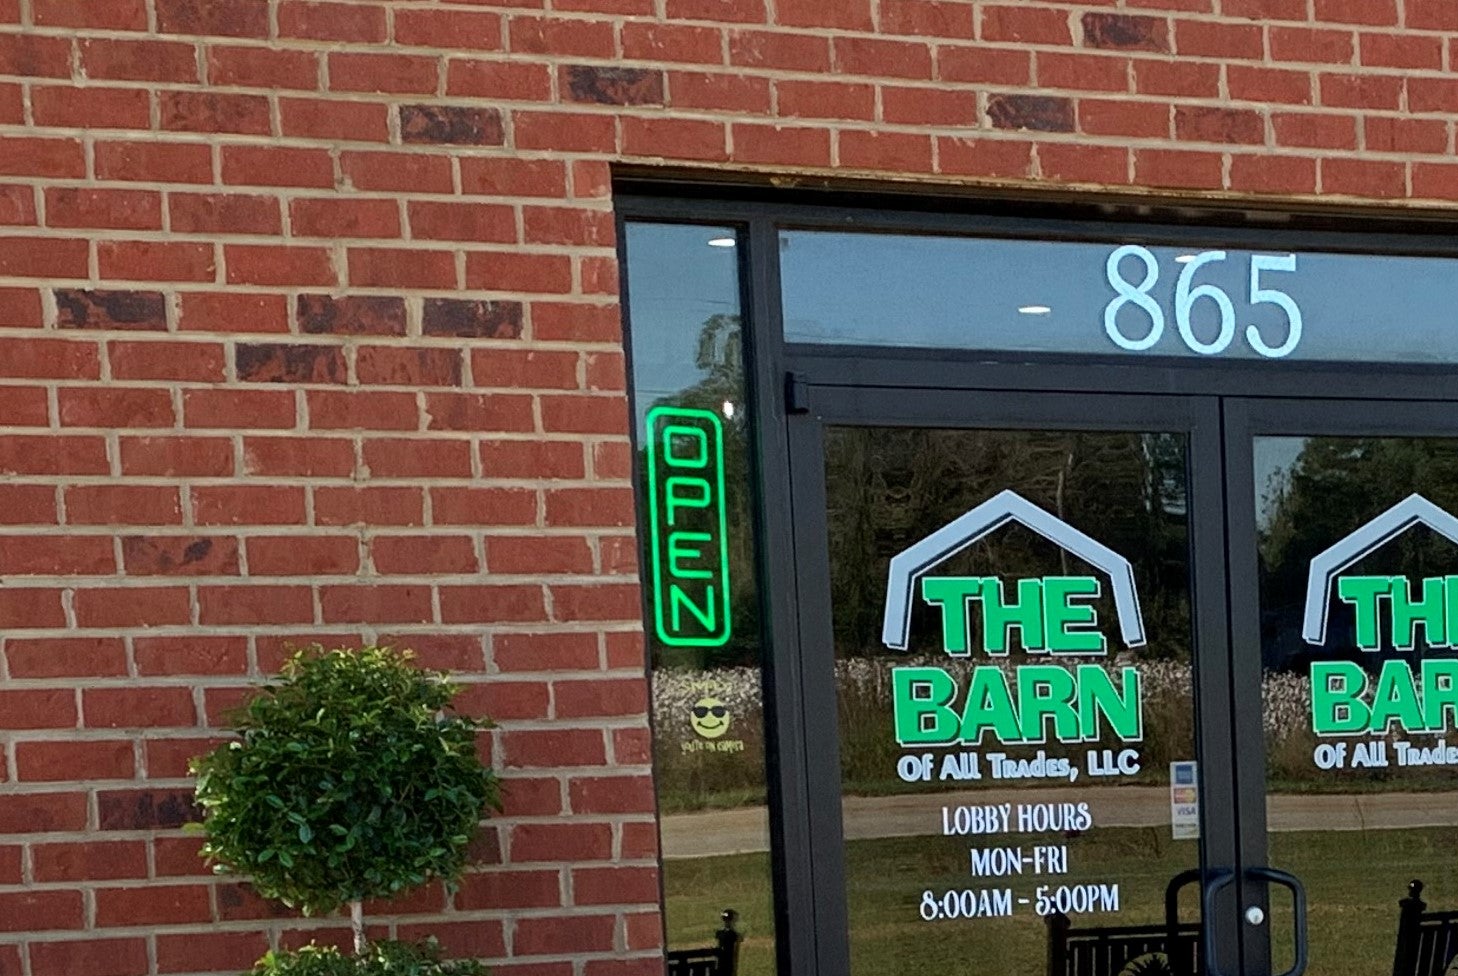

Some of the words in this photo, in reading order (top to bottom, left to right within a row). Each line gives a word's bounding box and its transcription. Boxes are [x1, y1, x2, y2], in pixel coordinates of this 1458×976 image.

[1104, 244, 1303, 359] 865
[662, 425, 717, 633] OPEN
[921, 575, 1107, 657] THE
[892, 664, 1144, 748] BARN
[897, 752, 935, 783] Of
[939, 751, 982, 781] All
[1087, 749, 1141, 776] LLC
[1313, 742, 1347, 769] Of
[1351, 740, 1389, 768] All
[942, 803, 1012, 836] LOBBY
[1017, 802, 1092, 833] HOURS
[970, 845, 1068, 877] MON-FRI
[919, 888, 1013, 921] 8:00AM
[1035, 884, 1120, 916] 5:00PM
